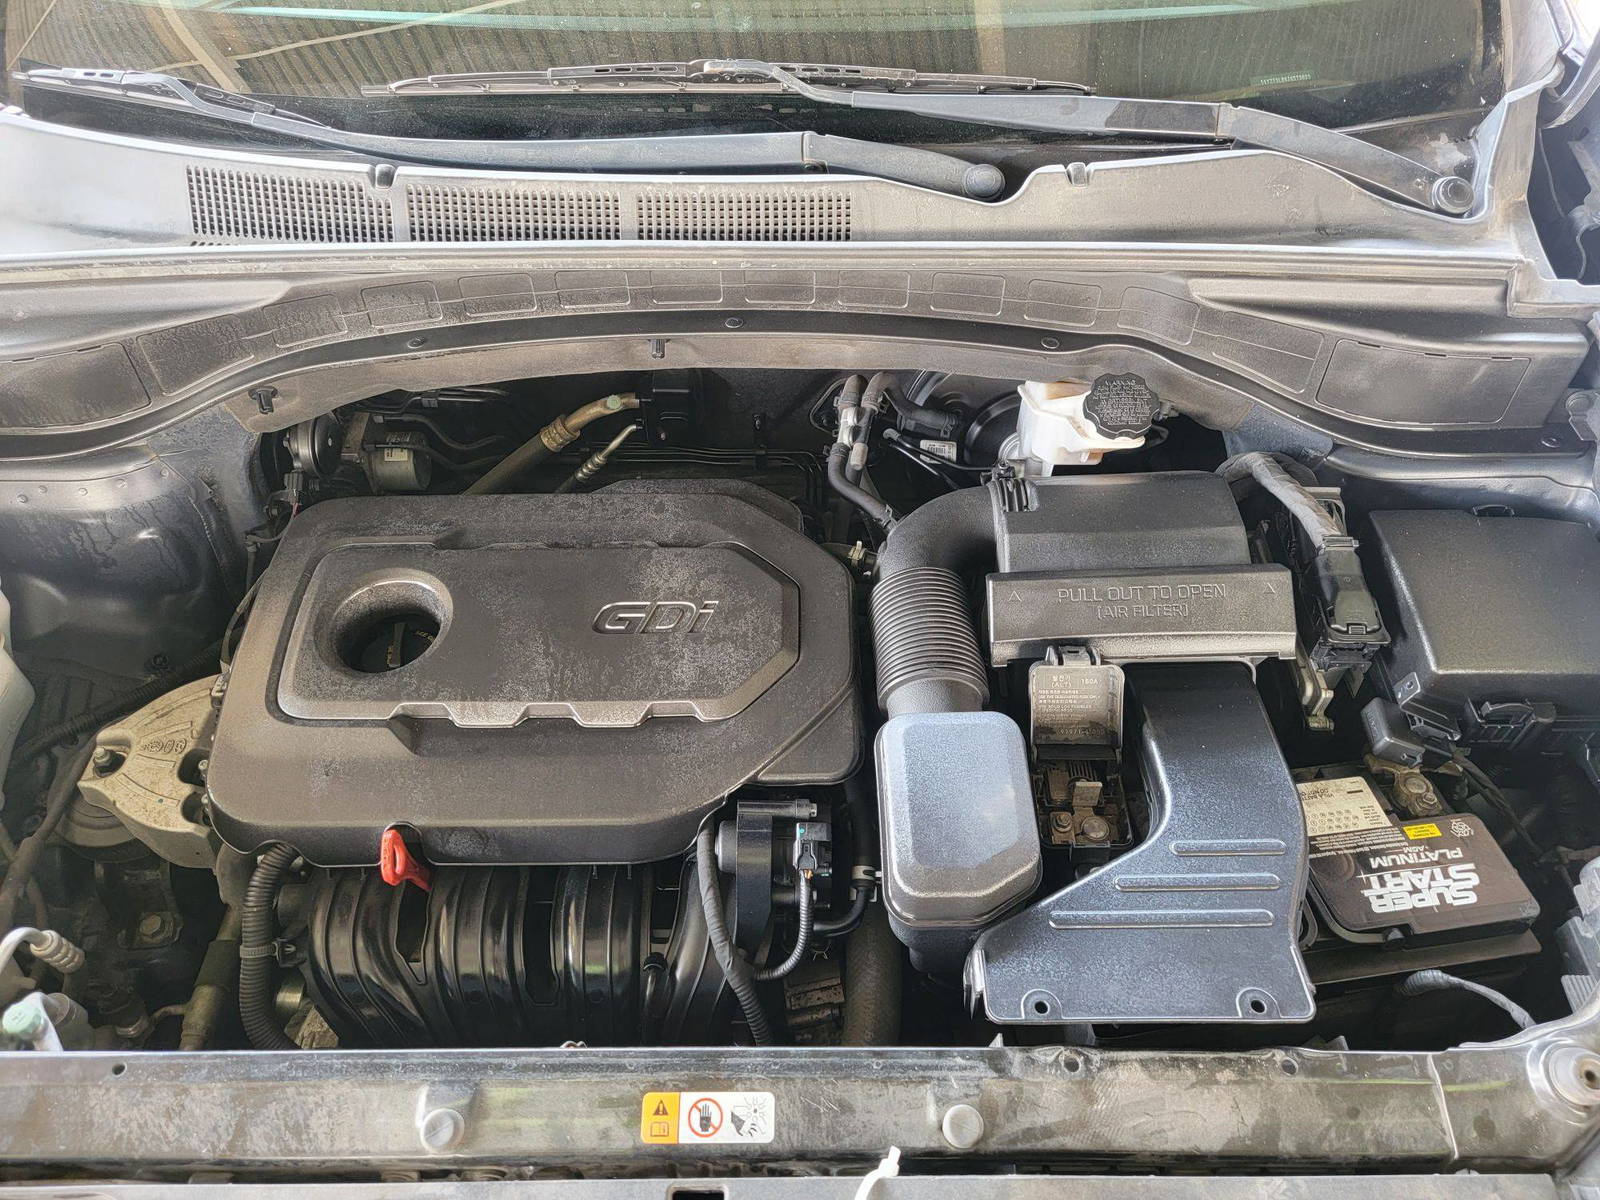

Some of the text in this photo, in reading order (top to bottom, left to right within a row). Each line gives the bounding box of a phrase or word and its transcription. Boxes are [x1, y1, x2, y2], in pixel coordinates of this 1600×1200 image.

[1057, 583, 1226, 602] PULL OUT TO OPEN
[592, 601, 719, 634] GDi
[1369, 848, 1463, 869] PLATINUM
[1361, 863, 1480, 897] START
[1368, 882, 1478, 913] SUPER
